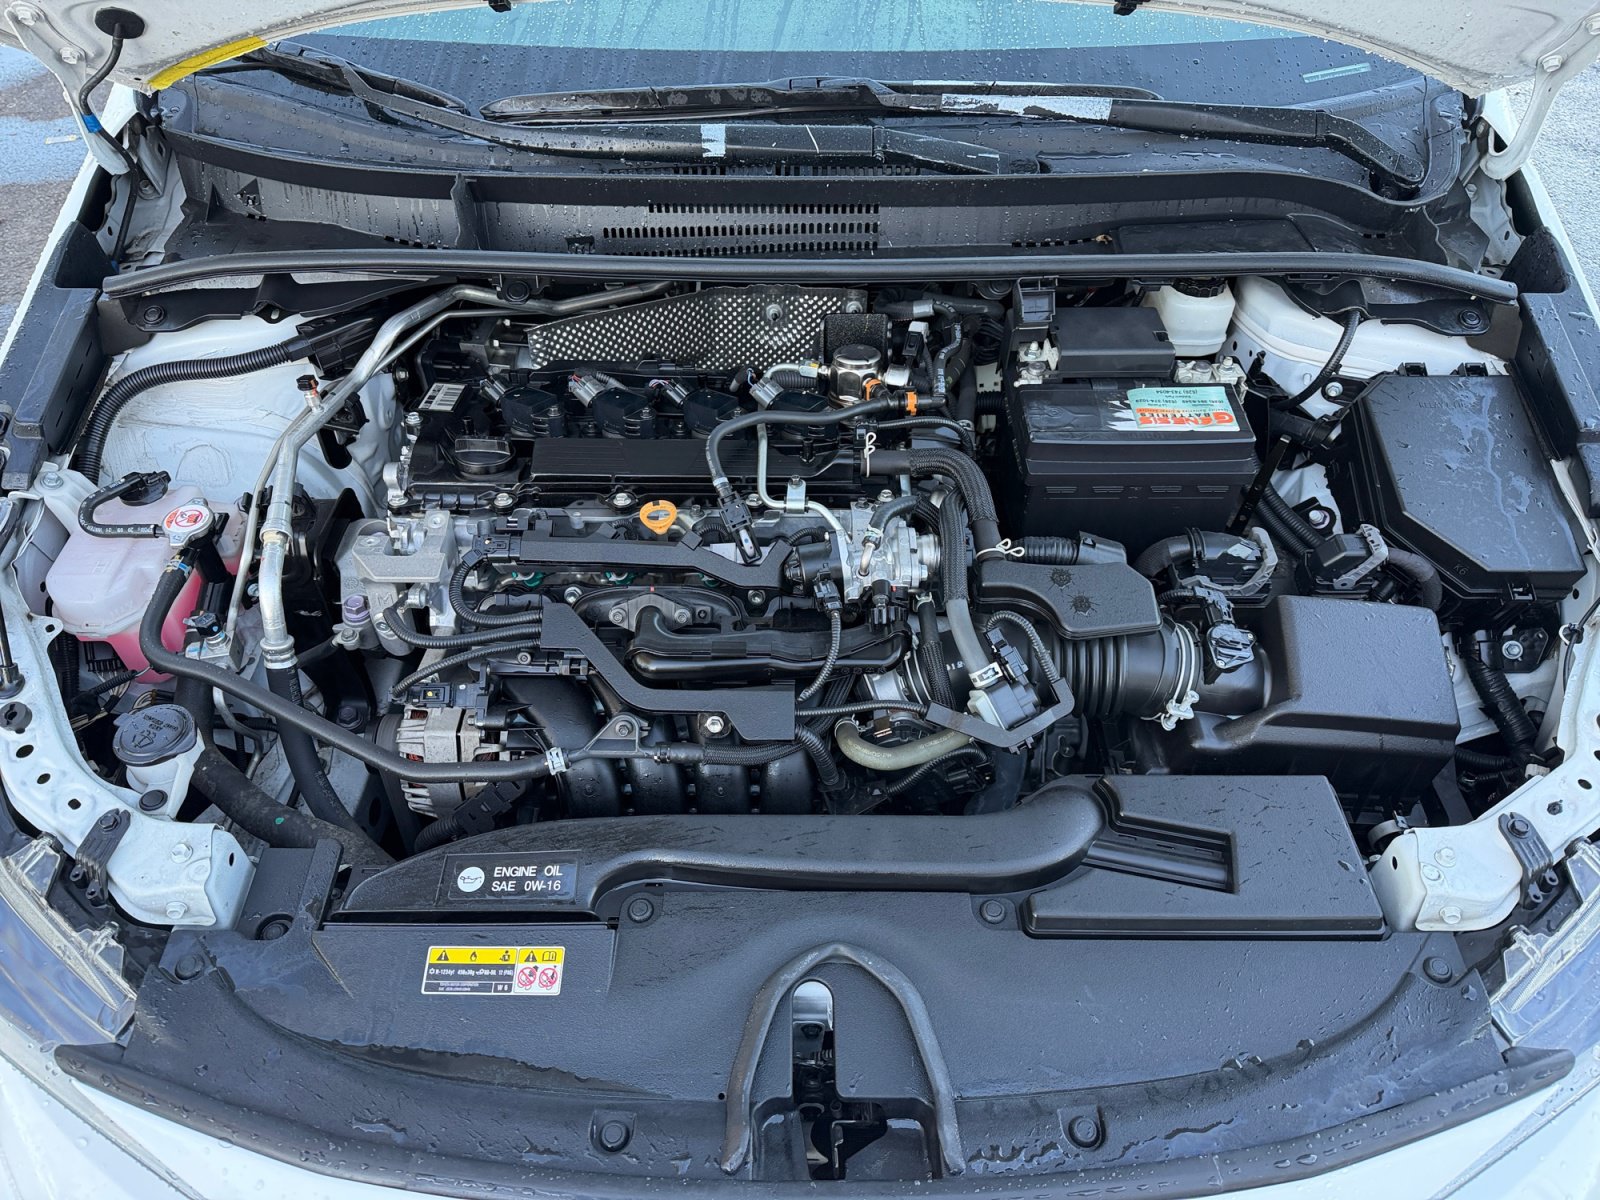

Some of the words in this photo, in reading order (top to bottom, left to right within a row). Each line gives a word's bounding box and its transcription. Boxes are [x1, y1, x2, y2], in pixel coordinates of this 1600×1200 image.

[1138, 412, 1234, 425] GENESIS
[493, 866, 538, 877] ENGINE
[544, 865, 563, 876] OIL
[491, 880, 517, 892] SAE
[524, 880, 561, 892] 0W-16
